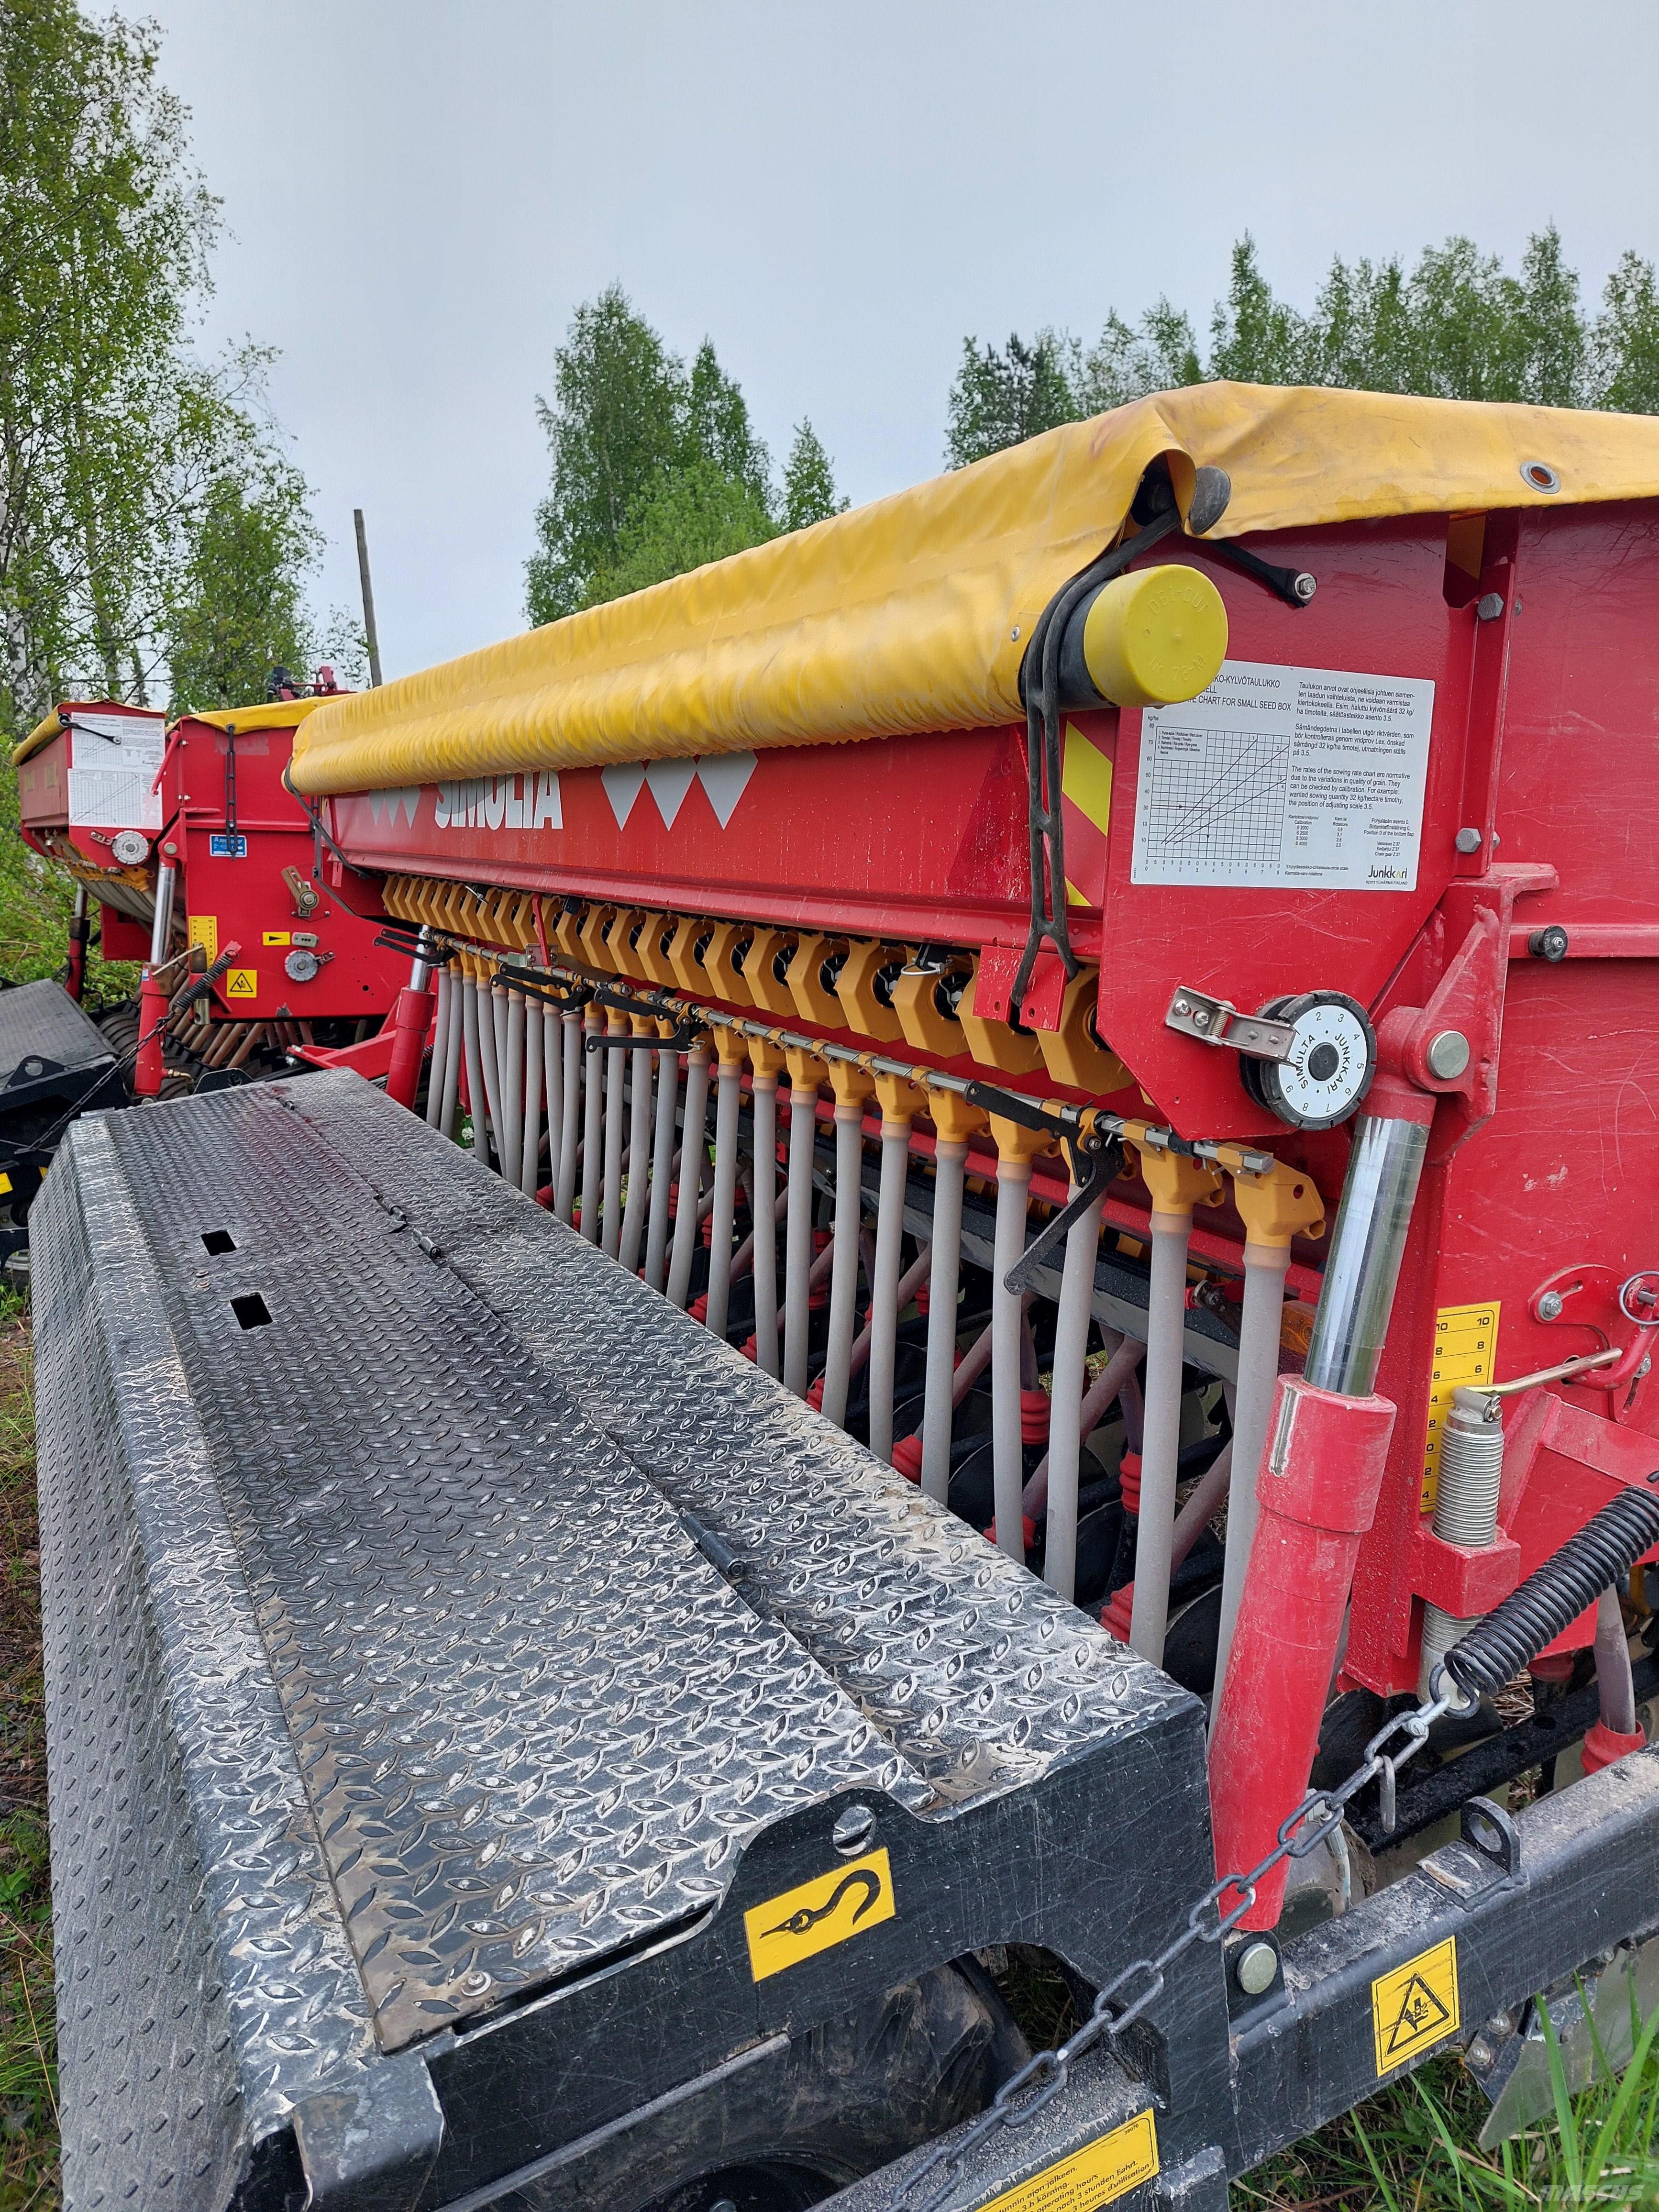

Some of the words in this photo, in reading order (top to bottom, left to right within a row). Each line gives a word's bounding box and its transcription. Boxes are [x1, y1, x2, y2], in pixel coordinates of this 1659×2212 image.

[1299, 682, 1322, 690] Taulukon
[1350, 687, 1375, 695] ohjeellisia
[1308, 691, 1325, 699] laadun
[1198, 695, 1221, 705] CHART
[1222, 697, 1236, 706] FOR
[1237, 699, 1258, 708] SMALL
[1259, 700, 1277, 710] SEED
[1278, 702, 1291, 711] BOX
[1304, 732, 1334, 741] kontrolleras
[1294, 741, 1318, 750] såmängd
[1327, 743, 1341, 751] kg/ha
[1361, 746, 1392, 755] utmatningen
[1349, 778, 1366, 786] quality
[1388, 779, 1401, 788] They
[1357, 794, 1383, 802] kg/hectare
[1326, 801, 1348, 810] adjusting
[1368, 865, 1407, 879] Junkkari
[1316, 1012, 1322, 1021] 2
[1338, 1014, 1344, 1023] 3
[1296, 1034, 1316, 1089] SIMULTA
[1327, 1033, 1350, 1094] JUNKKARI
[1302, 1102, 1309, 1111] 8
[1326, 1104, 1331, 1112] 7
[1436, 1322, 1448, 1331] 10
[1477, 1317, 1490, 1326] 10
[1435, 1347, 1443, 1355] 8
[1433, 1371, 1440, 1379] 6
[1475, 1365, 1482, 1373] 6
[1431, 1395, 1439, 1403] 4
[1429, 1419, 1436, 1428] 2
[1426, 1443, 1434, 1452] 0
[1027, 2185, 1045, 2198] ajon
[1047, 2166, 1078, 2188] jälkeen.
[1037, 2189, 1074, 2212] operating
[1076, 2174, 1098, 2190] hours
[1057, 2198, 1075, 2212] nach
[1085, 2174, 1114, 2195] stunden
[1080, 2190, 1105, 2208] heures
